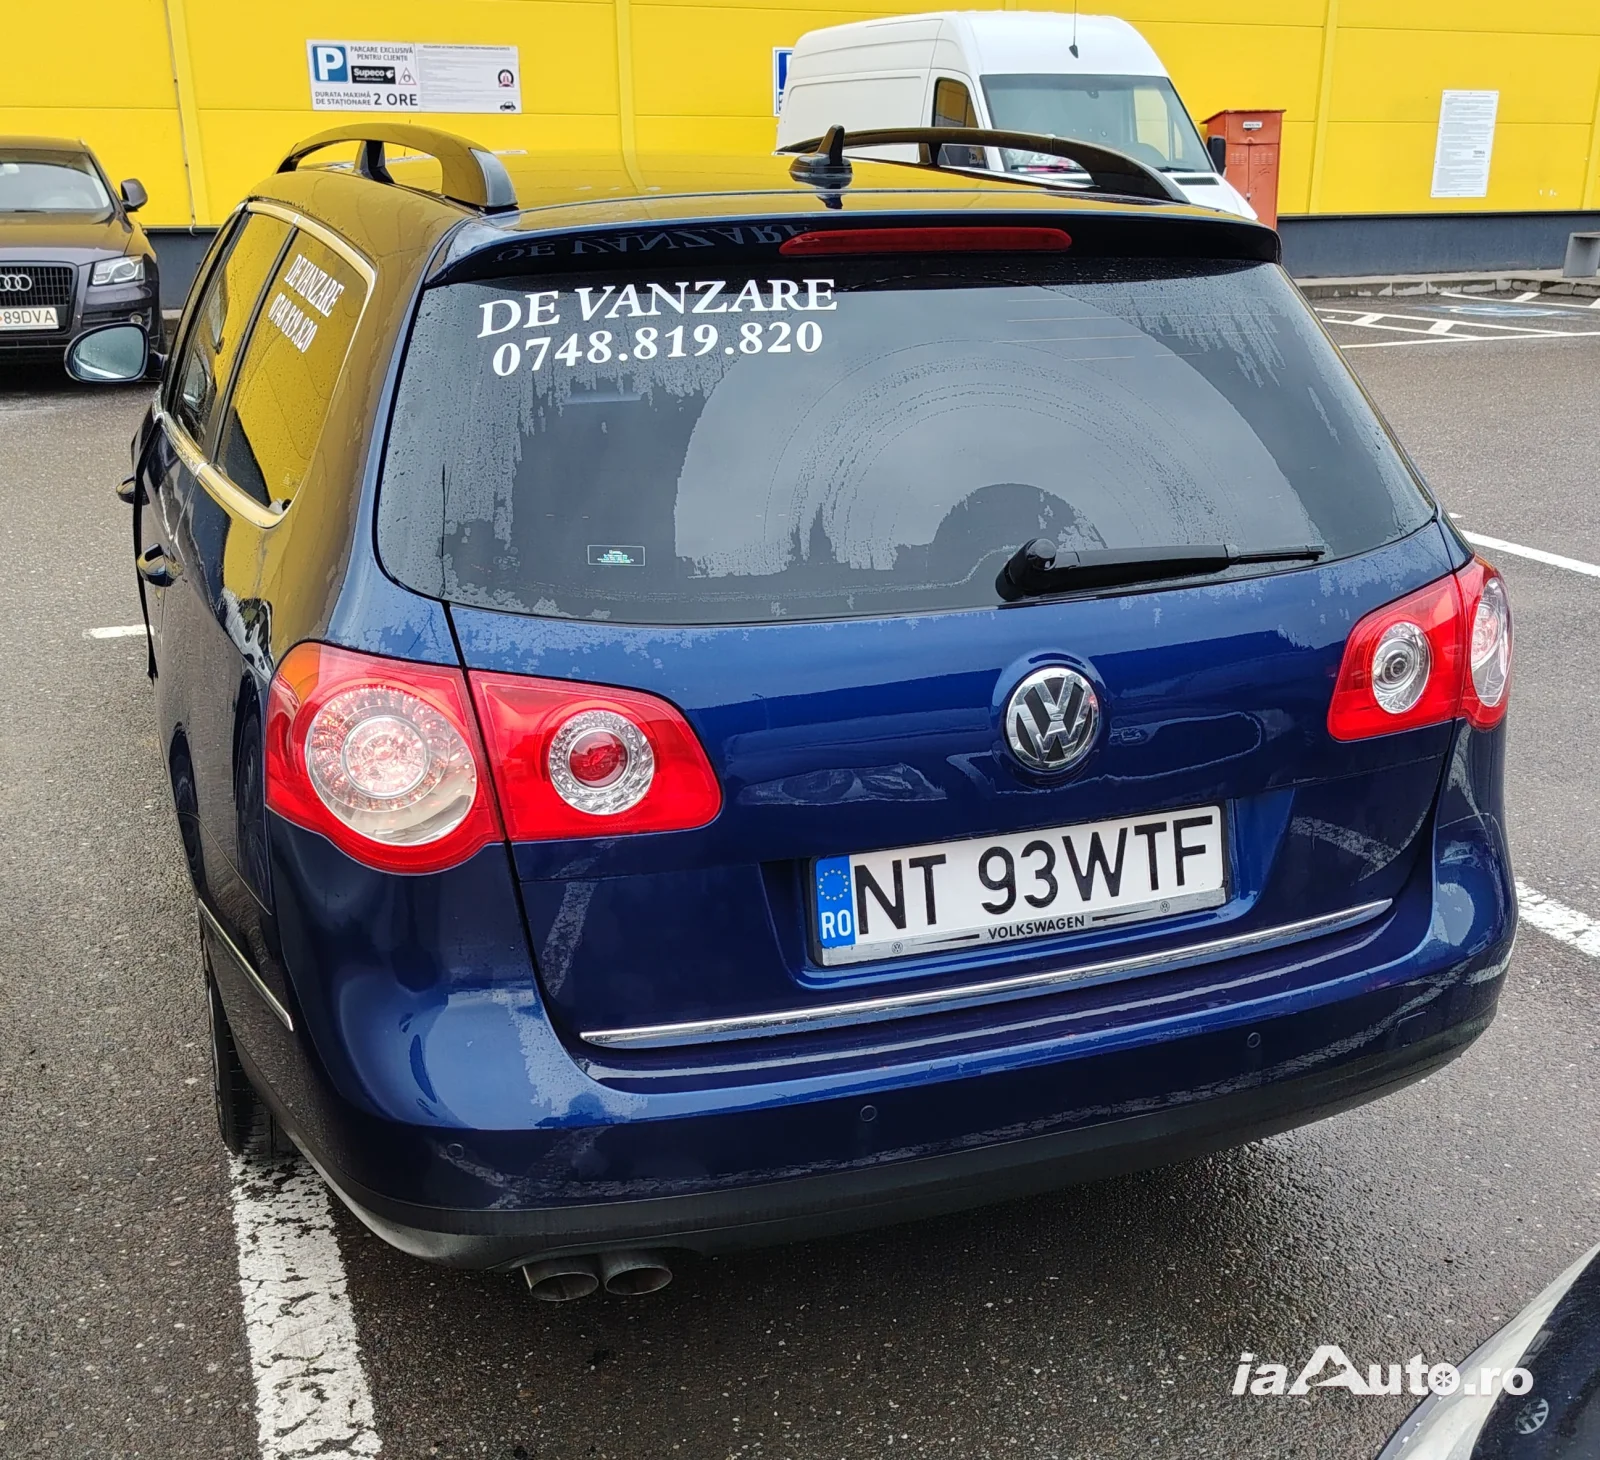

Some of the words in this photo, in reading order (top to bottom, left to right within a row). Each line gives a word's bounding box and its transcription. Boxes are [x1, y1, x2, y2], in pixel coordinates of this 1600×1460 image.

[316, 47, 344, 80] P
[353, 67, 385, 78] Supeco
[373, 93, 382, 105] 2
[386, 93, 418, 106] ORE
[284, 253, 308, 288] DE
[294, 261, 345, 318] VANZARE
[3, 310, 56, 324] 89DVA
[477, 290, 561, 338] DE
[574, 278, 838, 322] VANZARE
[492, 321, 823, 377] 0748.819.820
[854, 854, 947, 936] NT
[978, 815, 1213, 916] 93WTF
[821, 909, 852, 940] RO
[988, 915, 1085, 940] VOLKSWAGEN
